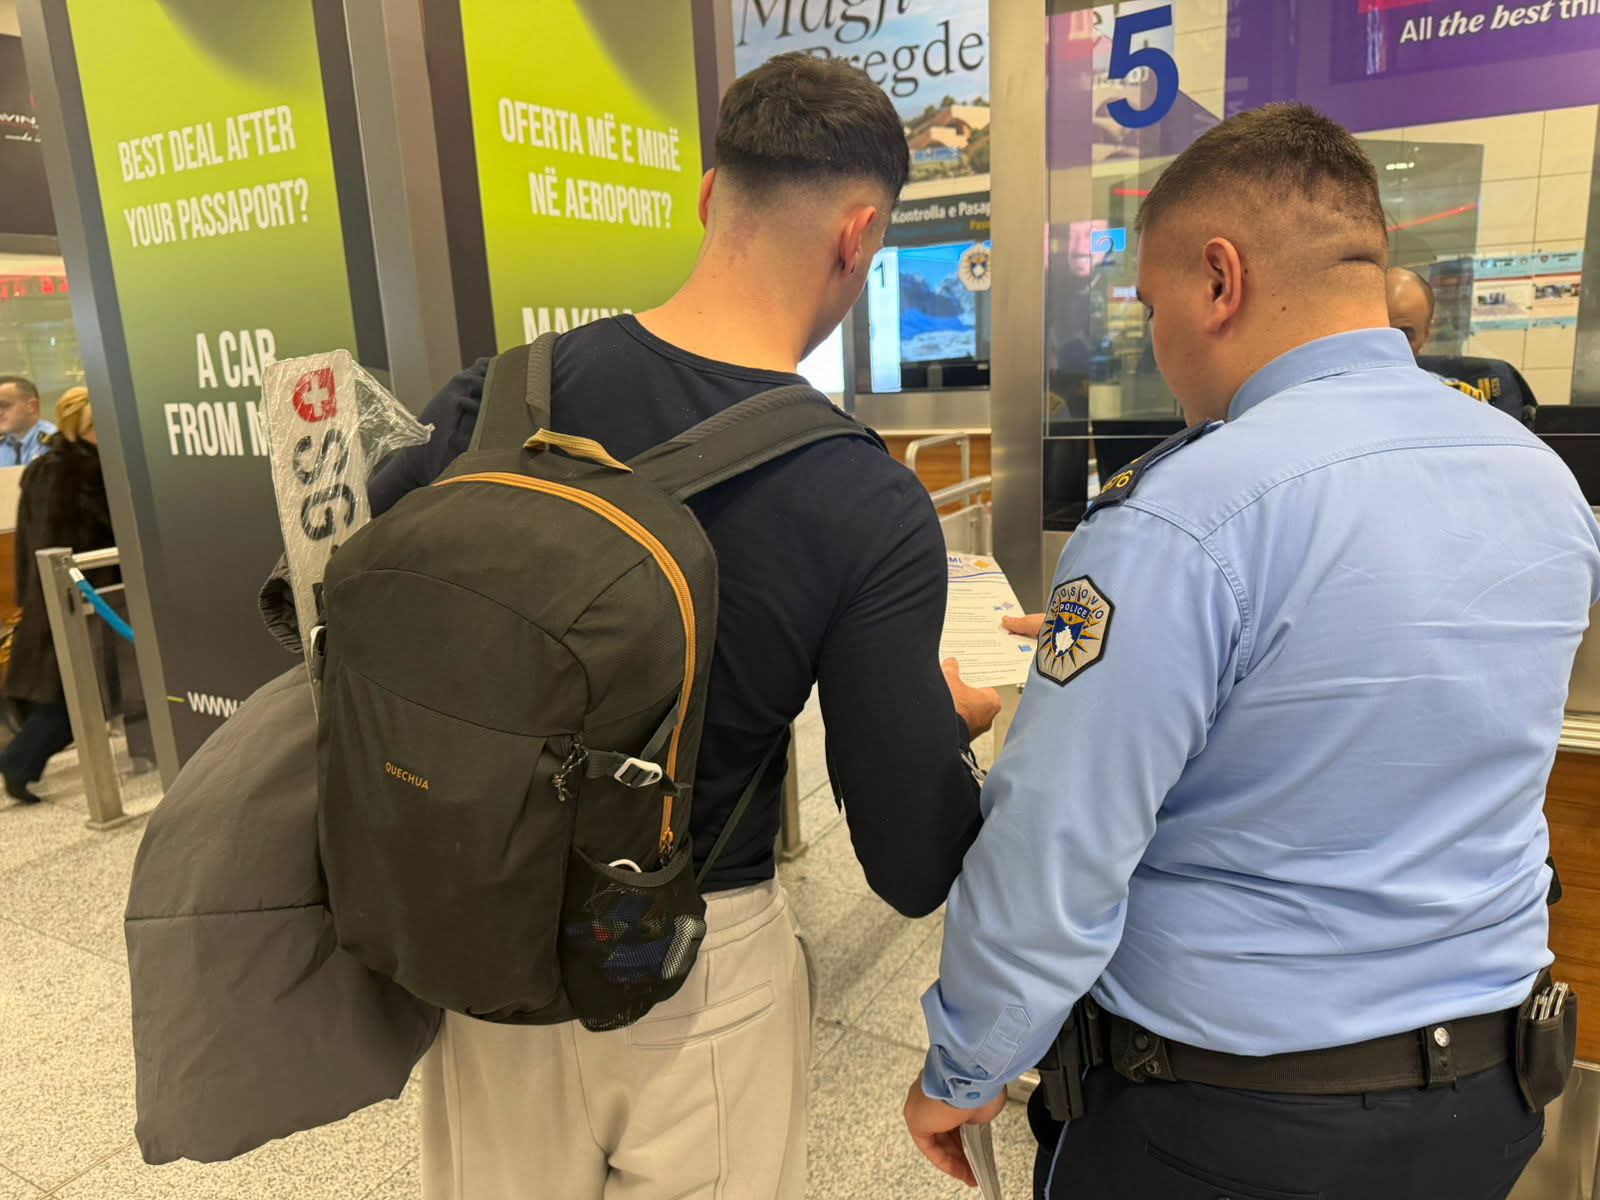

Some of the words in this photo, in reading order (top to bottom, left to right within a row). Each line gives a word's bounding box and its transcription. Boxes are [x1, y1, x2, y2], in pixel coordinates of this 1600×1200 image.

[1400, 15, 1433, 44] All
[1438, 10, 1485, 38] the
[1490, 0, 1555, 31] best
[1106, 3, 1180, 129] 5
[117, 132, 166, 183] BEST
[167, 121, 224, 173] DEAL
[226, 104, 297, 161] AFTER
[498, 97, 585, 156] OFERTA
[586, 112, 619, 161] MË
[620, 123, 635, 164] E
[637, 127, 682, 173] MIRË
[123, 202, 177, 248] YOUR
[176, 177, 310, 241] PASSAPORT?
[528, 166, 561, 217] NË
[565, 177, 673, 230] AEROPORT?
[196, 332, 219, 389] A
[219, 327, 278, 389] CAR
[163, 401, 245, 457] FROM
[1060, 603, 1088, 618] POLICE
[385, 761, 430, 790] QUECHUA
